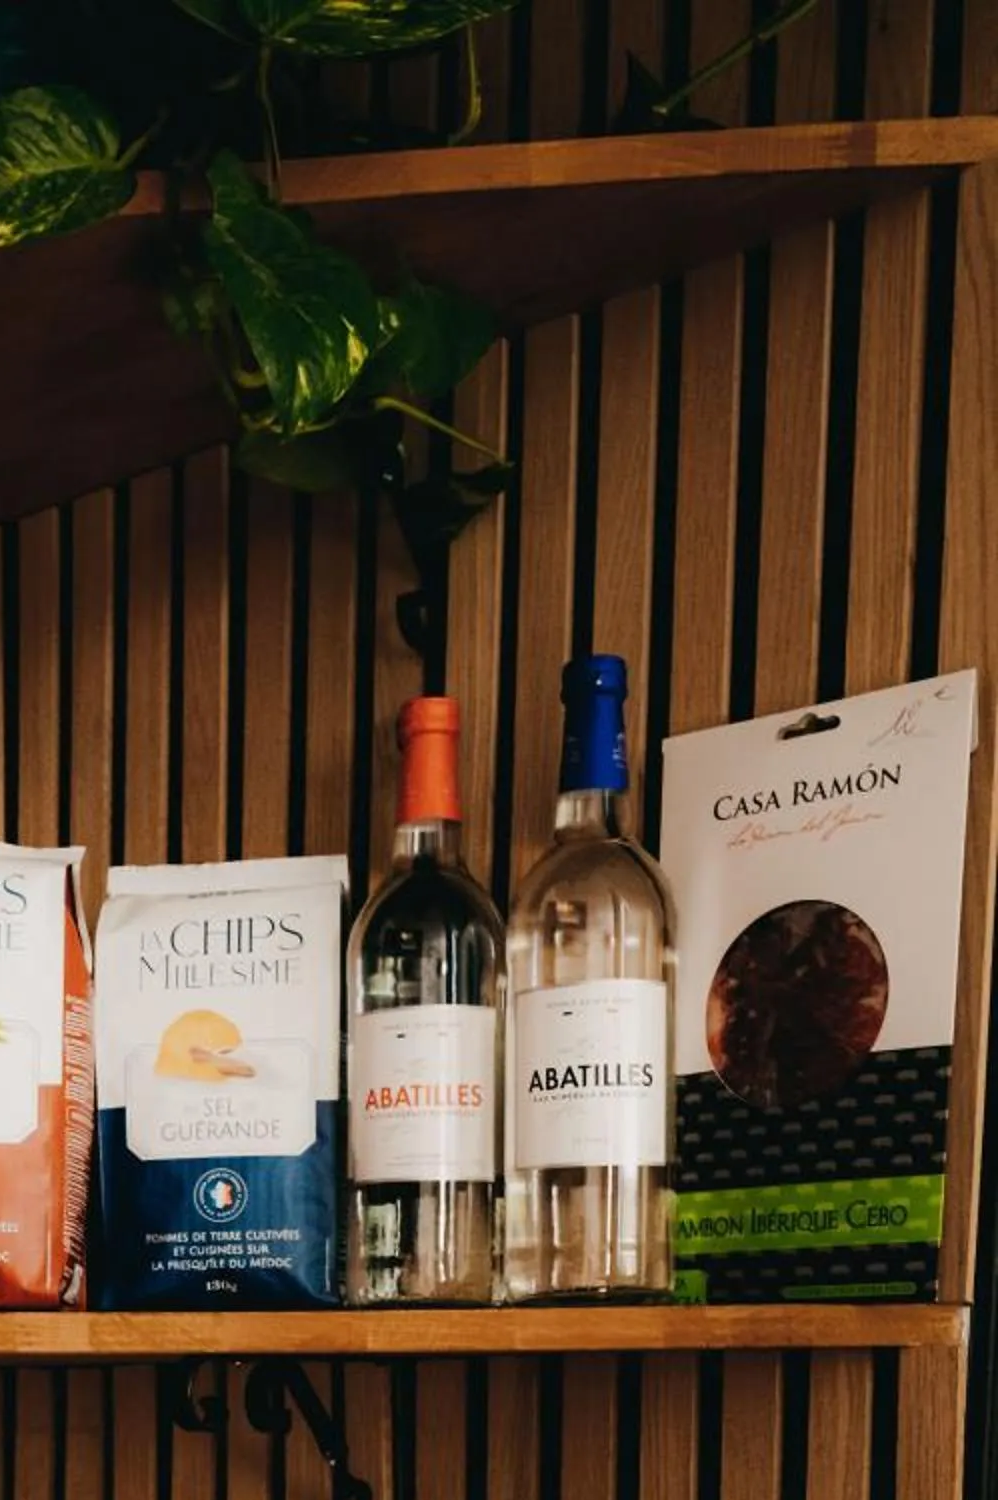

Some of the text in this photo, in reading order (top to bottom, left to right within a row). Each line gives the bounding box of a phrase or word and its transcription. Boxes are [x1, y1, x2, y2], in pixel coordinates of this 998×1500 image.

[713, 764, 901, 821] CASA RAMÓN
[169, 913, 304, 959] CHIPS
[529, 1063, 653, 1093] ABATILLES
[203, 1096, 235, 1117] SEL
[365, 1084, 482, 1112] ABATILLES
[678, 1215, 743, 1238] AMBON
[845, 1200, 909, 1229] CEBO
